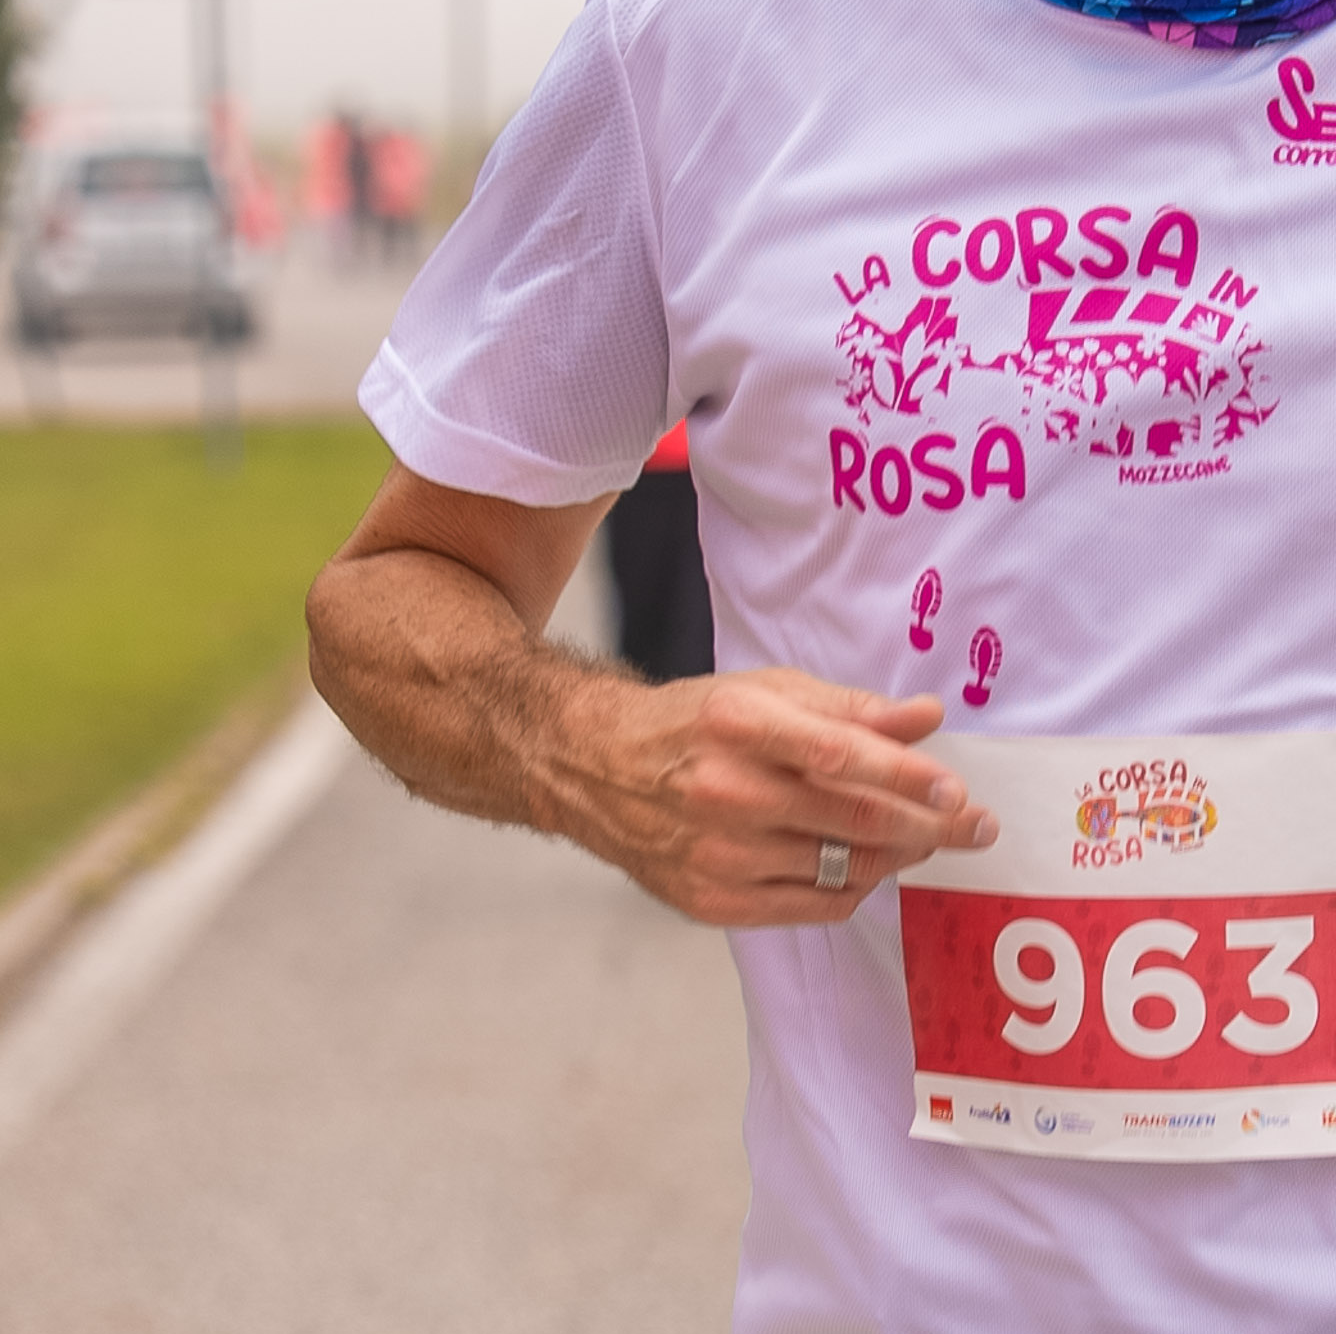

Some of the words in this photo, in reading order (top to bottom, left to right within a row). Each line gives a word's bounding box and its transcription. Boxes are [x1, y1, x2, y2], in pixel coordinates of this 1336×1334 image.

[834, 254, 891, 306] LA
[911, 204, 1201, 291] CORSA
[1209, 269, 1259, 306] IN
[828, 417, 1027, 516] ROSA
[1073, 781, 1094, 802] LA
[1098, 758, 1189, 793] CORSA
[1071, 834, 1143, 869] ROSA
[992, 913, 1320, 1061] 963
